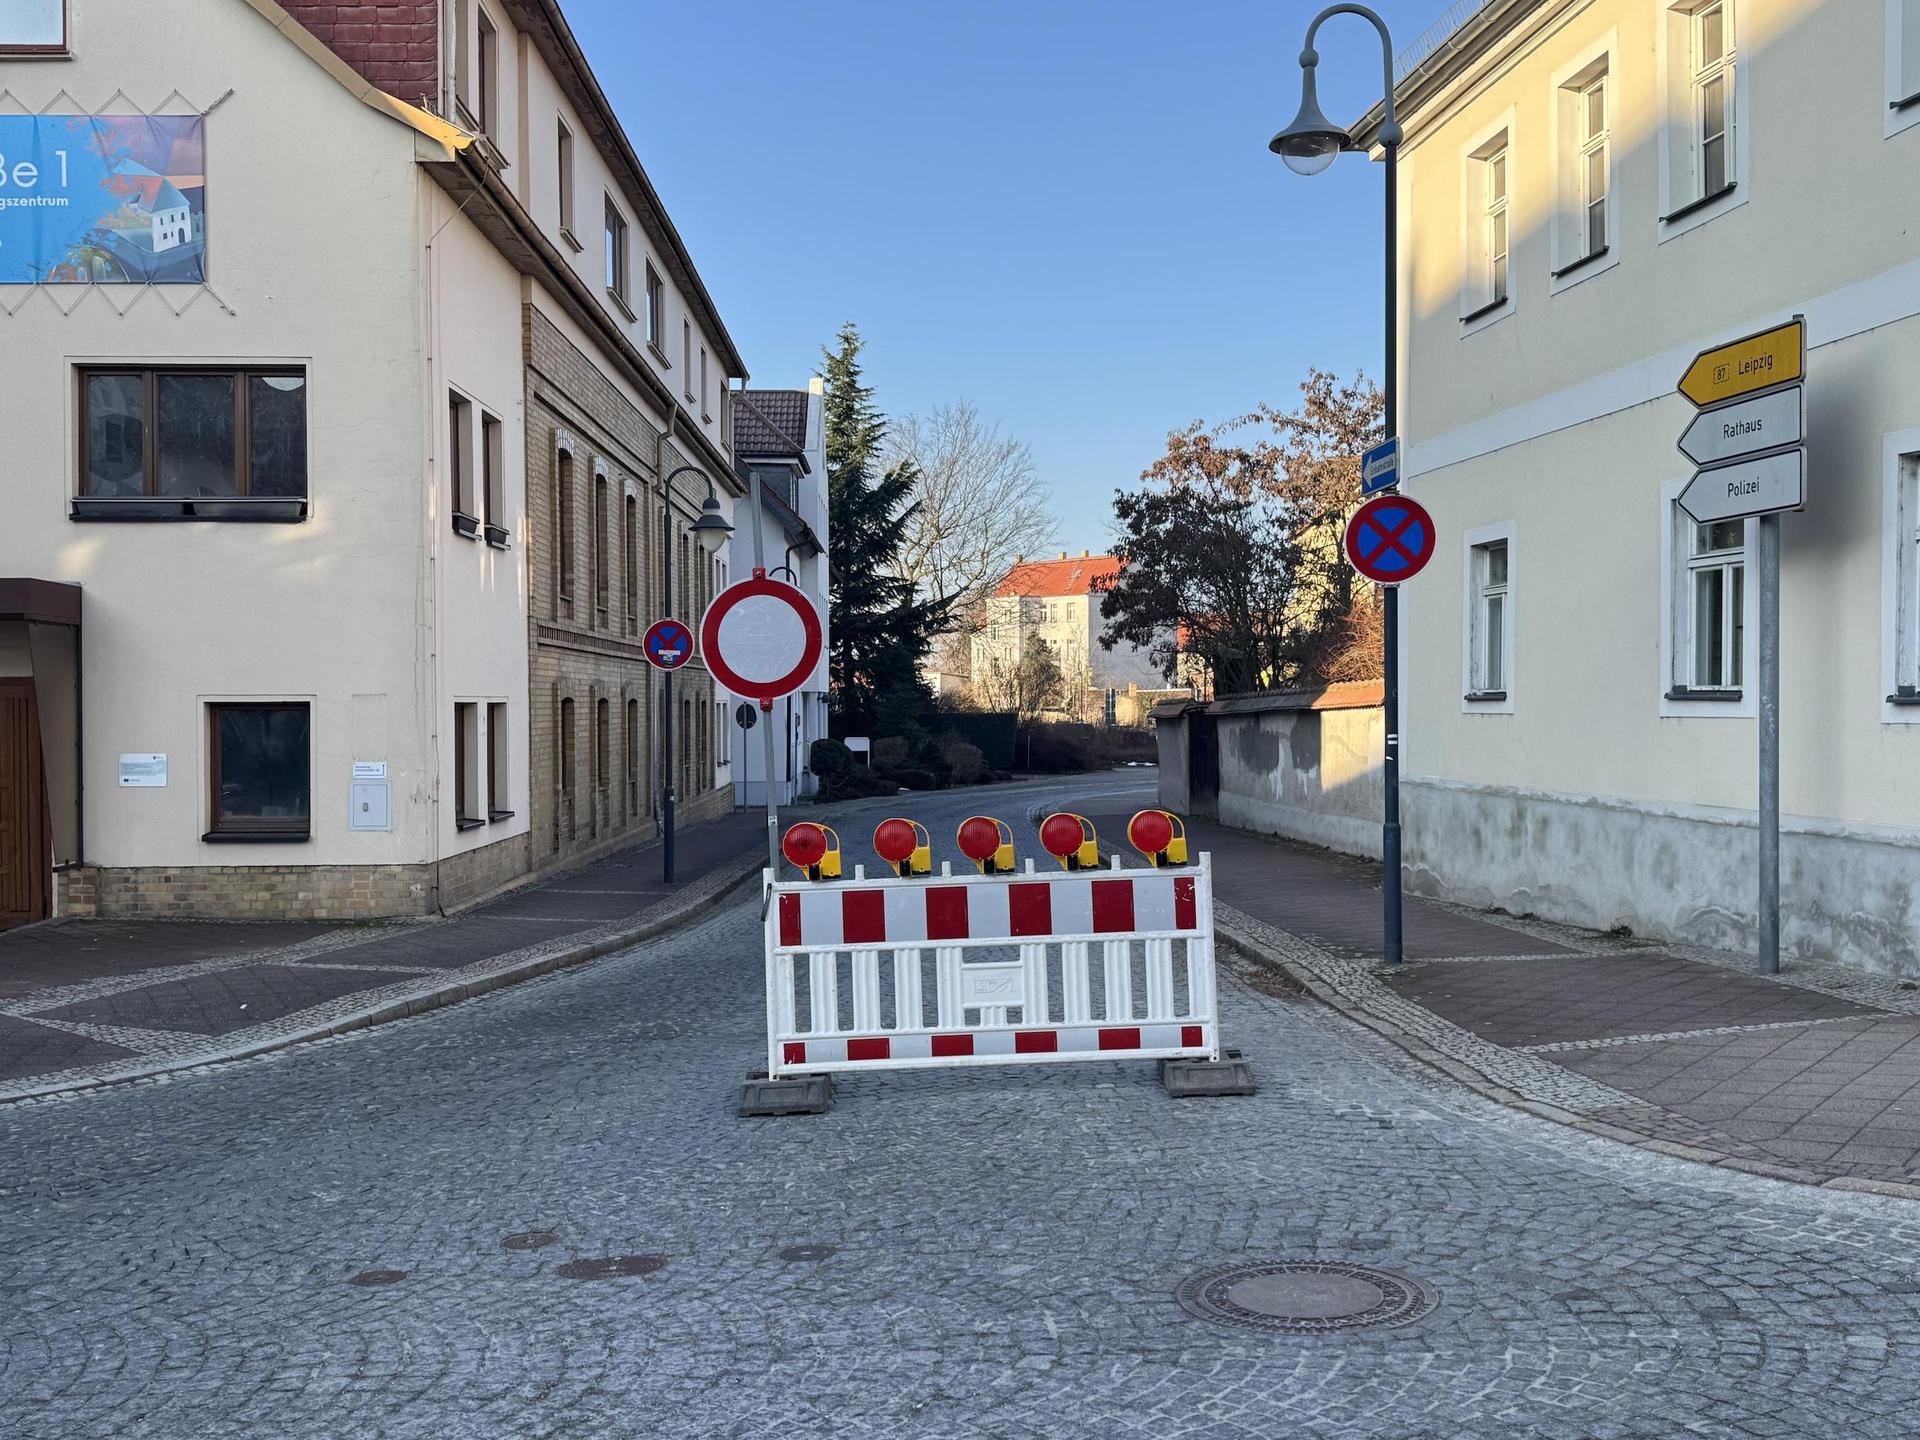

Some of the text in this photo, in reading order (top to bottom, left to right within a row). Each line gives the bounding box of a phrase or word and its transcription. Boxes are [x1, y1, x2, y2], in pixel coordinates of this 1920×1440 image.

[55, 150, 67, 187] 1
[1717, 352, 1773, 381] 87 Leipzig
[1723, 418, 1762, 440] Rathaus
[1727, 476, 1760, 498] Polizei
